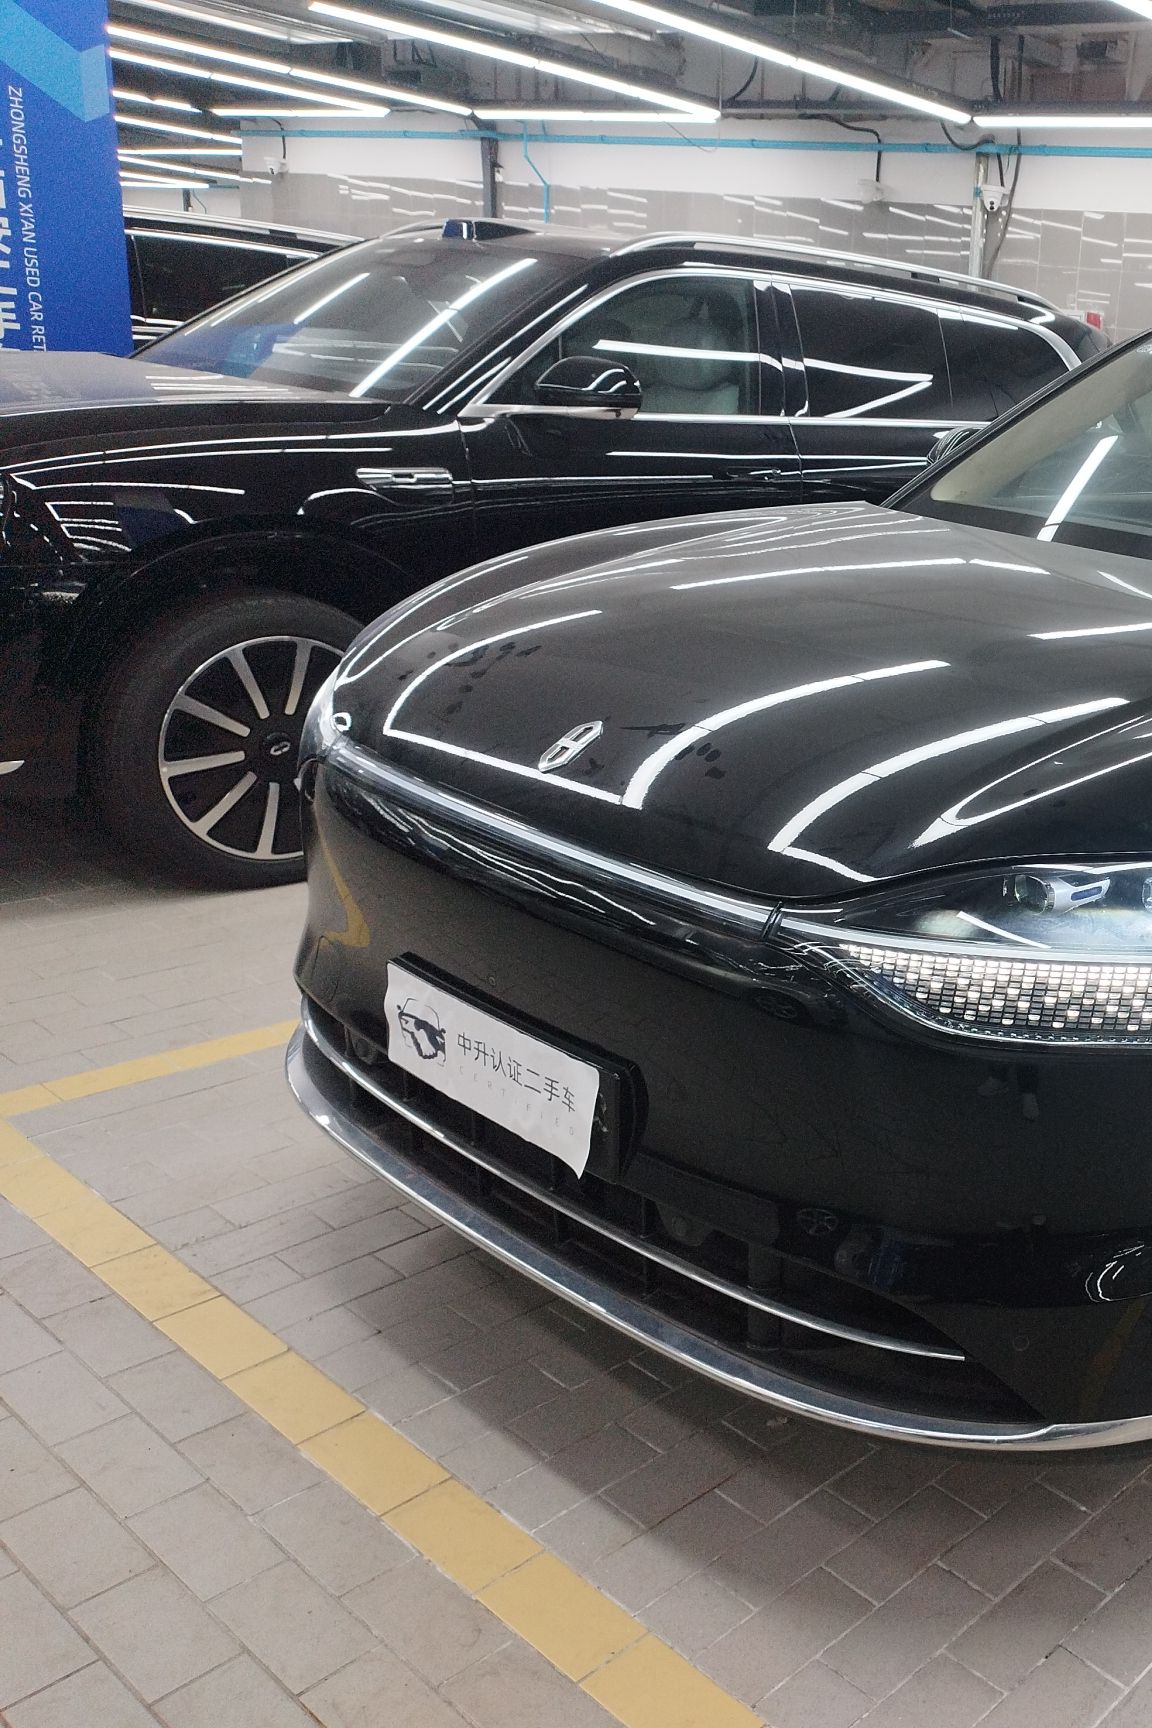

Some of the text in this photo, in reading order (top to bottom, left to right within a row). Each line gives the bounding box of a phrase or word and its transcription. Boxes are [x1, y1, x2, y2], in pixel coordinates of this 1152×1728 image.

[8, 85, 32, 198] ZHONGSHENG
[23, 247, 41, 287] USED
[28, 291, 43, 321] CAR
[31, 325, 47, 352] RET
[457, 1031, 576, 1112] 中升认证二手车
